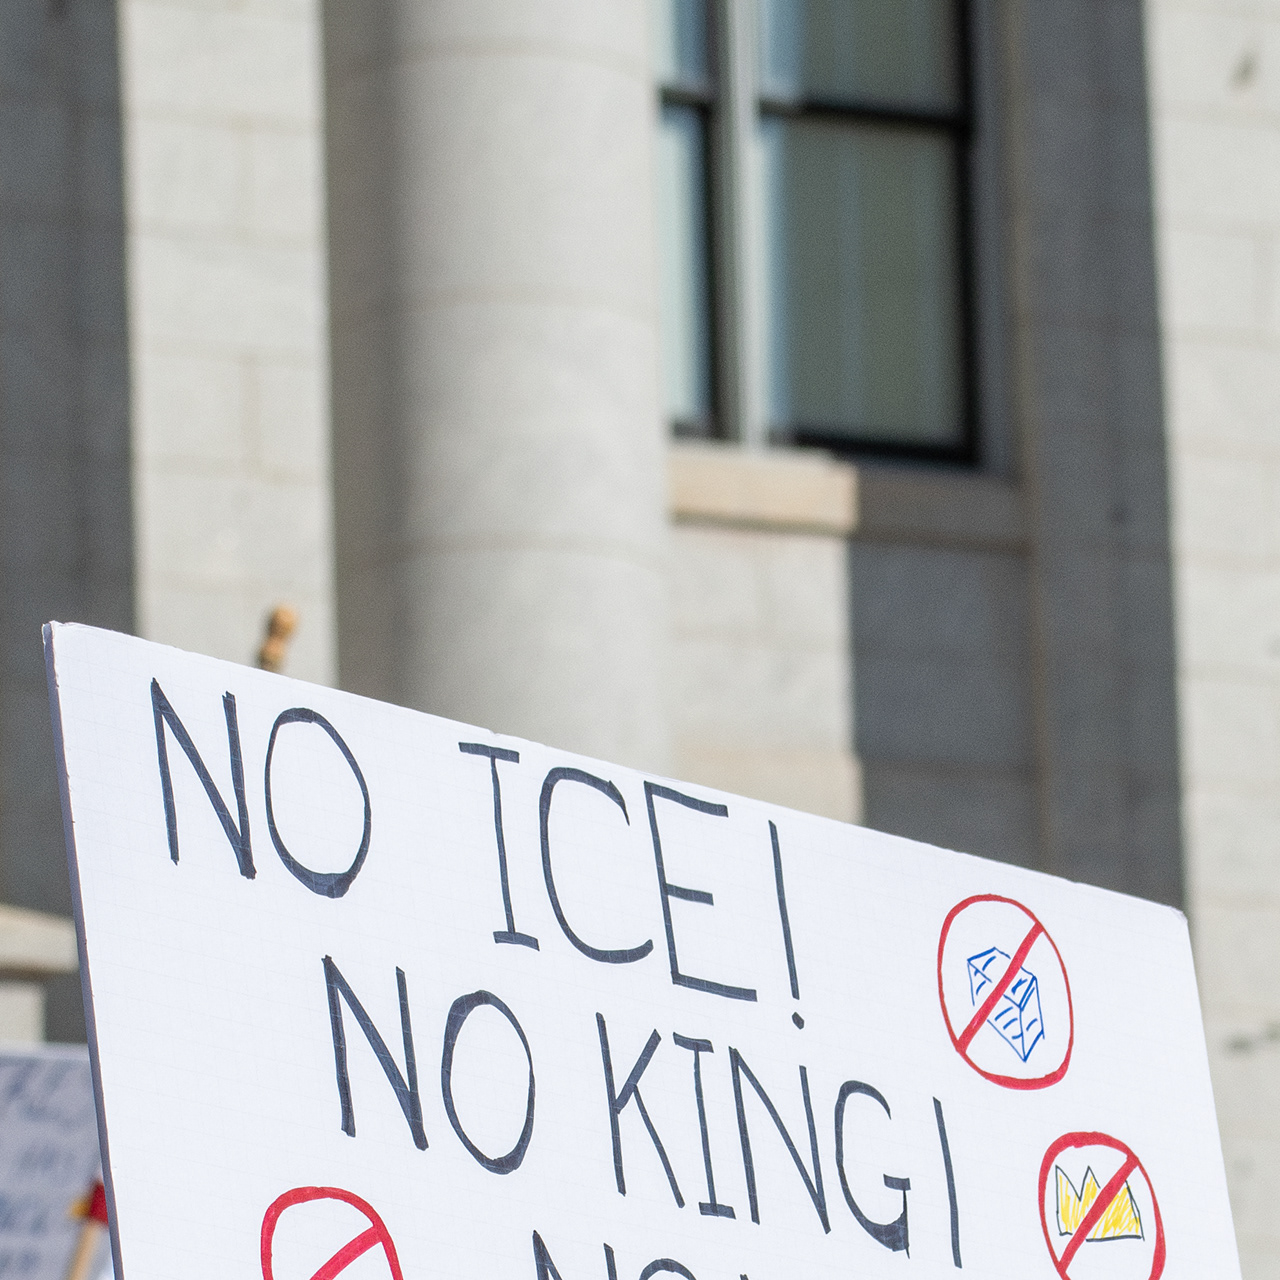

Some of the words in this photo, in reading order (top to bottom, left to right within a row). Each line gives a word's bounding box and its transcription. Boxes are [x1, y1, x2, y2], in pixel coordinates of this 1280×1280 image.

[150, 677, 372, 899] NO
[458, 741, 808, 1030] ICE!
[321, 954, 536, 1175] NO
